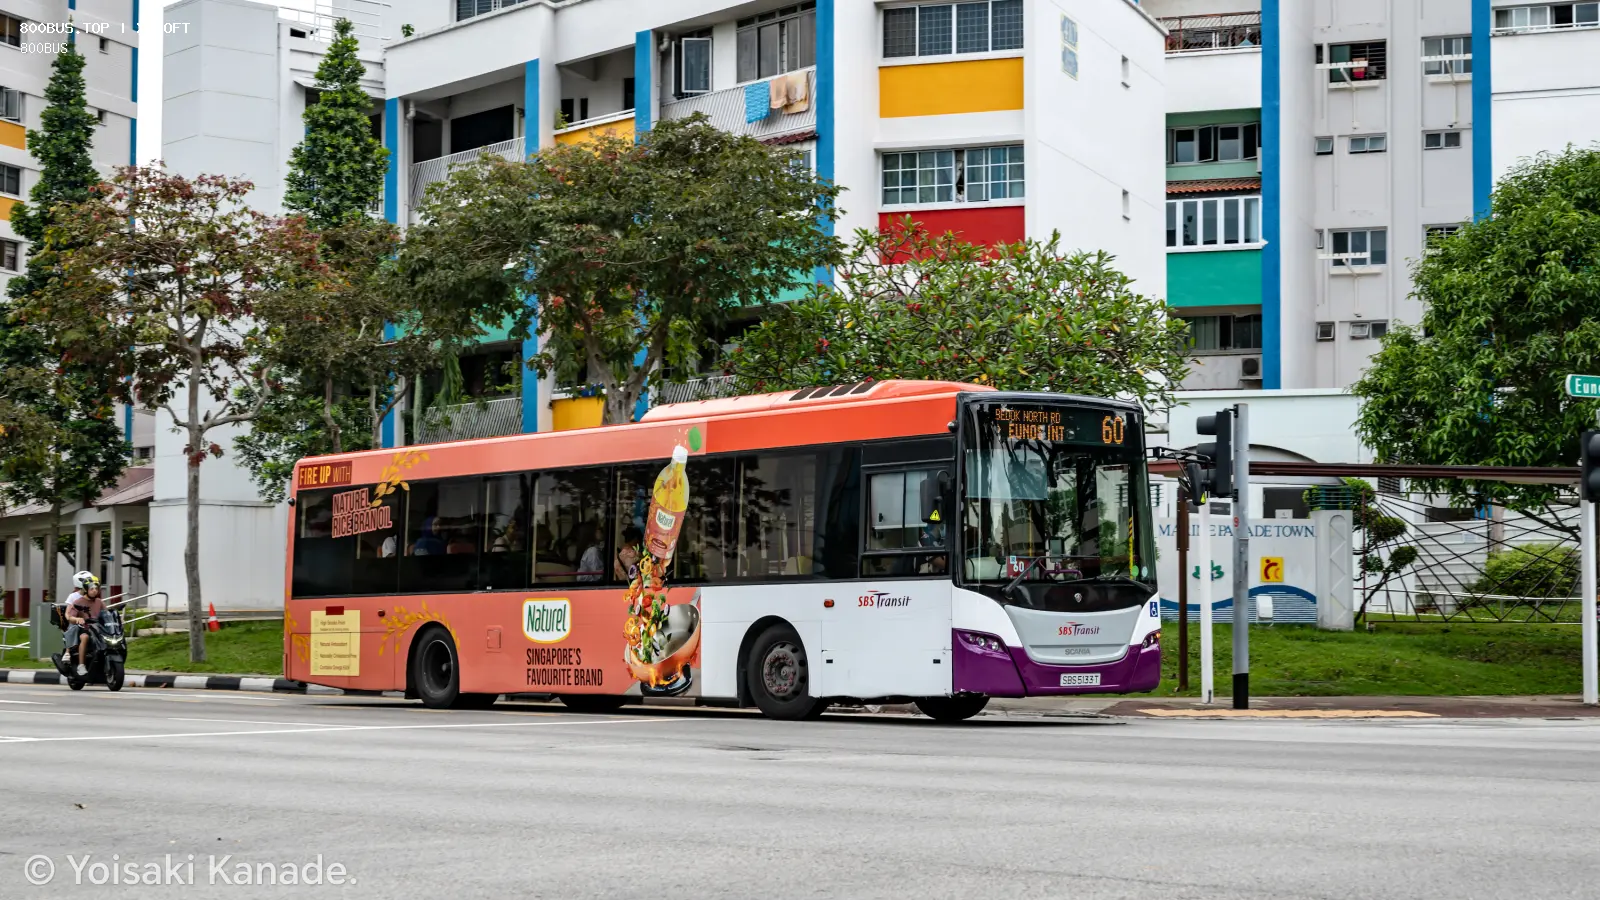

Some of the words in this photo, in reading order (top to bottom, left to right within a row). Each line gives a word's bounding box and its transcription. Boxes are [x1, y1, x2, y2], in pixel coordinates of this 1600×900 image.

[995, 408, 1020, 421] BEDOK
[1023, 410, 1048, 423] NORTH
[1050, 412, 1061, 424] RD
[1047, 425, 1065, 441] INT
[1101, 415, 1124, 445] 60
[299, 466, 317, 485] FIRE
[319, 465, 331, 484] UP
[333, 466, 351, 483] WITH
[333, 488, 371, 516] NATUREL
[332, 513, 352, 538] RICE
[352, 508, 378, 535] BRAN
[378, 506, 392, 530] OIL
[1274, 525, 1315, 537] TOWN
[858, 595, 874, 607] SBS
[872, 592, 912, 609] Transit
[527, 603, 567, 632] Naturel
[1058, 626, 1072, 636] SBS
[1071, 623, 1100, 636] Transit
[526, 648, 581, 665] SINGAPORE'S
[1065, 648, 1091, 656] SCANIA
[526, 668, 572, 686] FAVOURITE
[574, 668, 603, 686] BRAND
